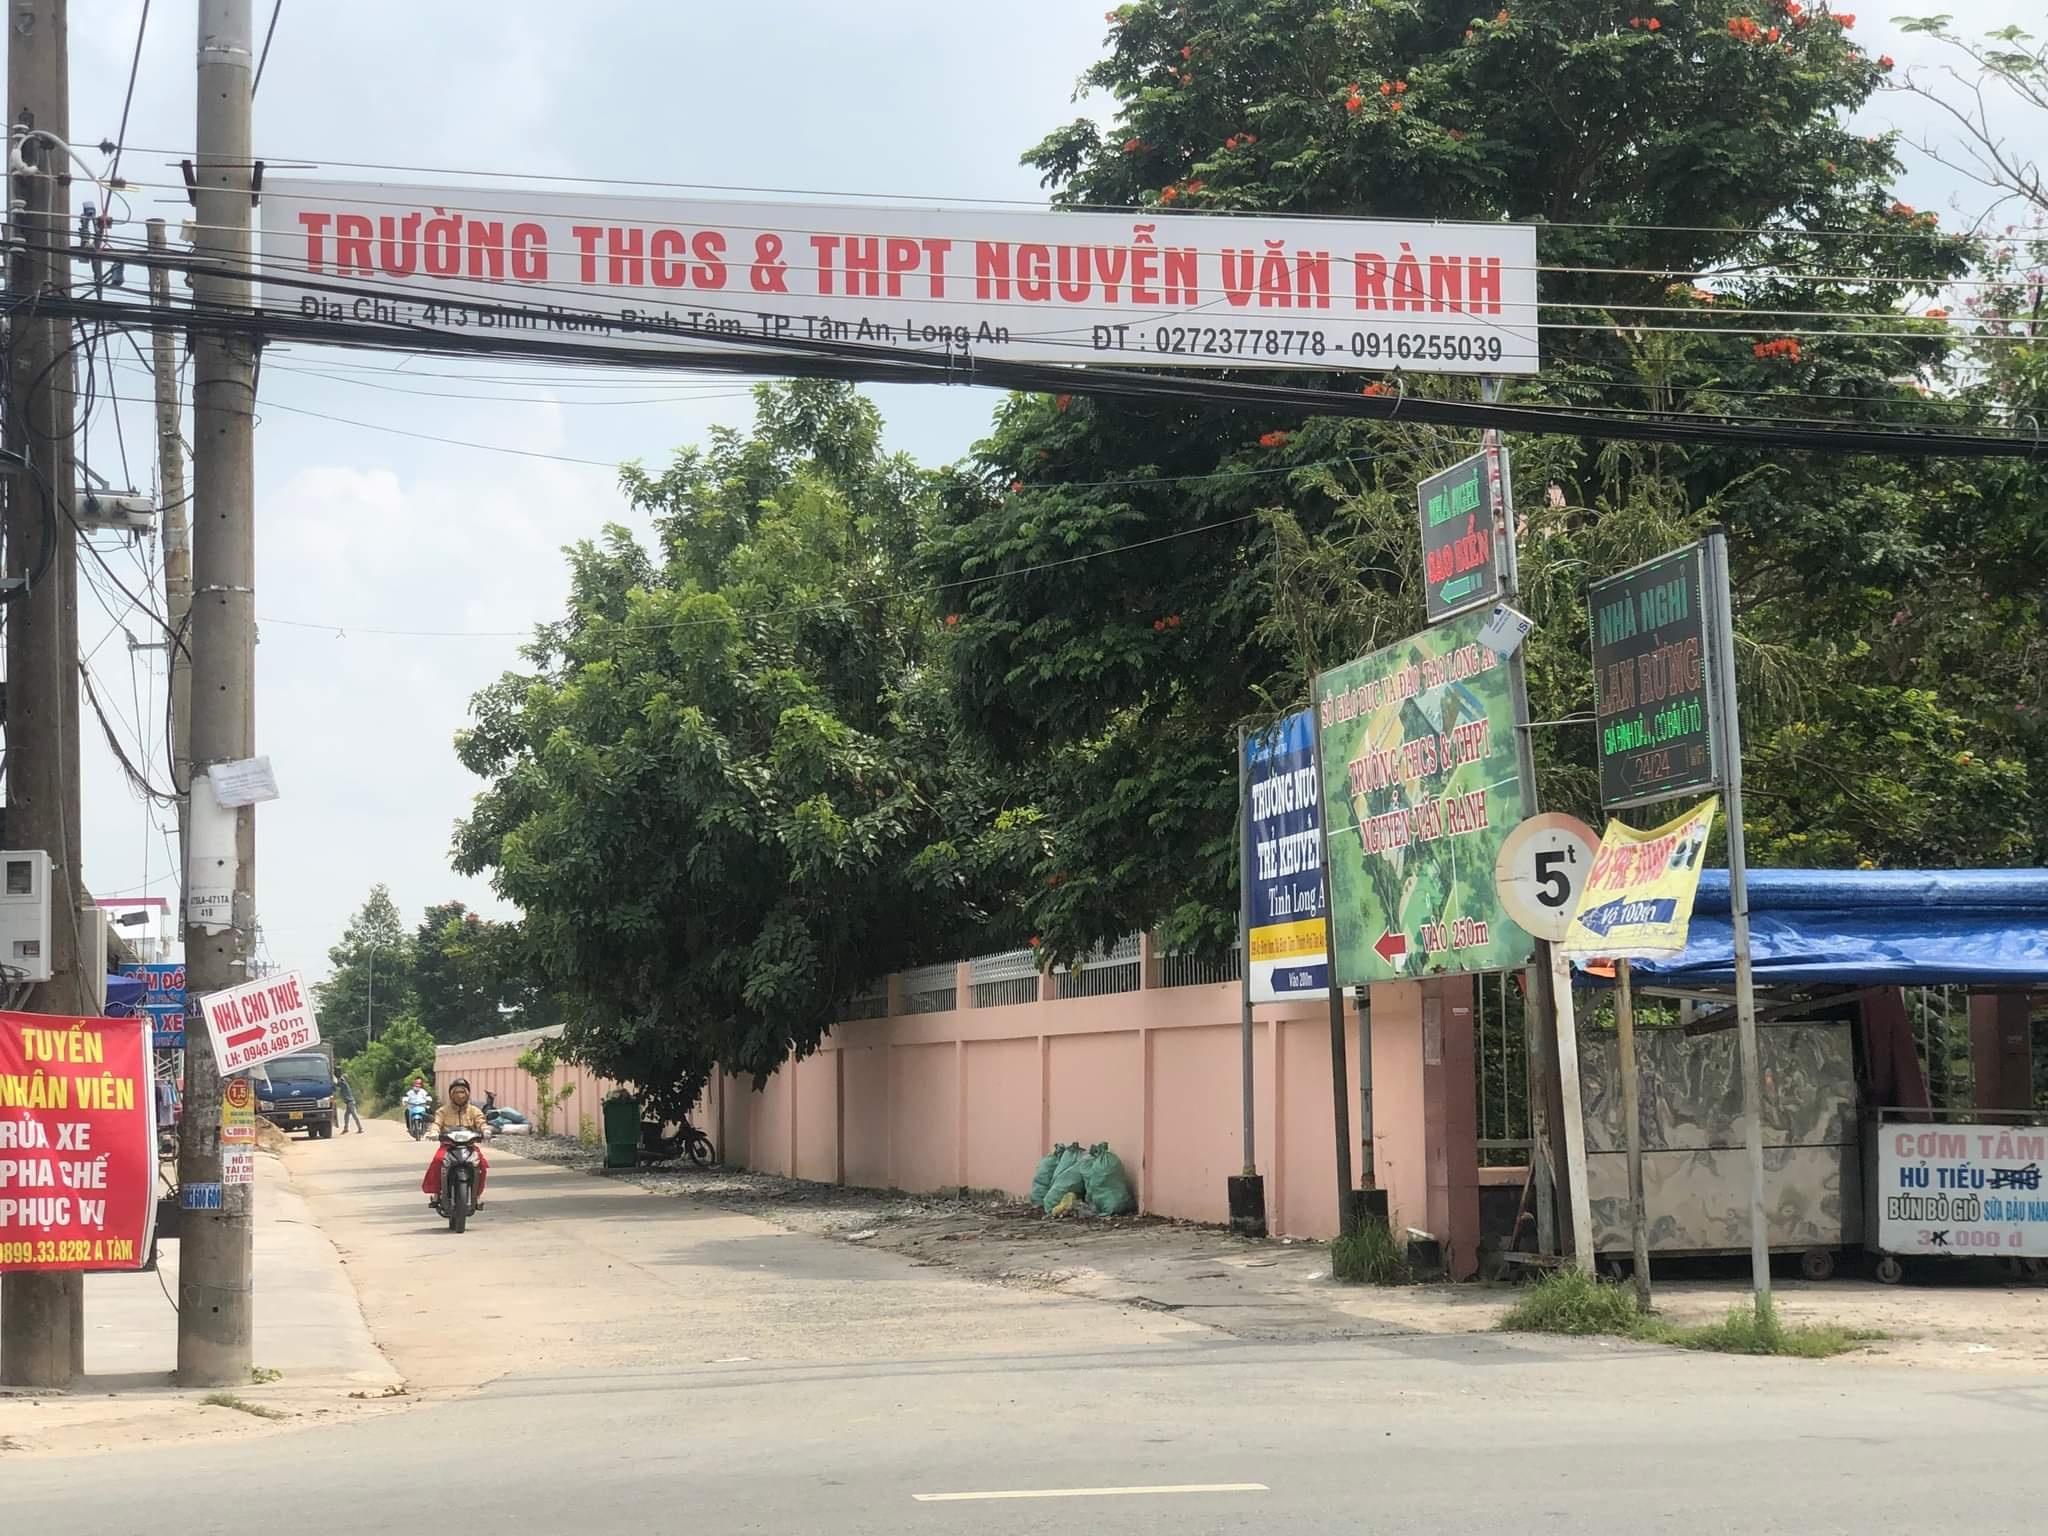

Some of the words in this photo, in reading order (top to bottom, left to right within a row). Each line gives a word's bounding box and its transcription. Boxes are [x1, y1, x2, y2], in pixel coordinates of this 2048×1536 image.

[299, 207, 547, 283] TRƯỜNG
[572, 226, 727, 289] THCS
[750, 233, 788, 292] &
[810, 235, 951, 298] THPT
[975, 224, 1198, 305] NGUYỄN
[1221, 239, 1330, 308] VĂN
[1354, 242, 1500, 314] RÀNH
[422, 303, 468, 326] 413
[803, 315, 849, 340] Tân
[856, 317, 897, 345] An,
[906, 319, 970, 349] Long
[976, 320, 1009, 345] An
[1092, 324, 1129, 351] ĐT
[1156, 326, 1325, 356] 02723778778
[1351, 331, 1501, 362] 0916255039
[1600, 589, 1637, 647] NHÀ
[1640, 565, 1688, 632] NGHỈ
[1446, 643, 1480, 684] LONG
[1598, 658, 1635, 717] LAN
[1638, 633, 1700, 705] RỪNG
[1402, 735, 1437, 781] THCS
[1452, 718, 1491, 765] THPT
[1635, 751, 1670, 781] 24/24
[1252, 766, 1294, 822] TRƯỜNG
[1257, 826, 1277, 880] TRẺ
[1268, 884, 1291, 916] Tỉnh
[1293, 883, 1316, 916] Long
[1420, 915, 1448, 953] VÀO
[1452, 919, 1489, 949] 250m
[161, 1013, 184, 1032] XE
[212, 994, 243, 1034] NHÀ
[241, 991, 269, 1024] CHO
[267, 975, 303, 1015] THUÊ
[21, 1020, 103, 1063] TUYỂN
[270, 1016, 304, 1034] 80m
[224, 1051, 242, 1068] LH:
[243, 1035, 289, 1061] 0949.499
[291, 1028, 310, 1046] 257
[75, 1071, 134, 1110] VIÊN
[0, 1112, 50, 1149] RỬA
[55, 1123, 90, 1150] XE
[1895, 1132, 1966, 1159] CƠM
[0, 1159, 55, 1188] PHA
[58, 1152, 110, 1189] CHẾ
[1900, 1160, 1929, 1188] HỦ
[1936, 1161, 1985, 1189] TIẾU
[0, 1197, 71, 1232] PHỤC
[1926, 1192, 1949, 1221] BÒ
[1951, 1193, 1980, 1222] GIÒ
[95, 1240, 103, 1260] A
